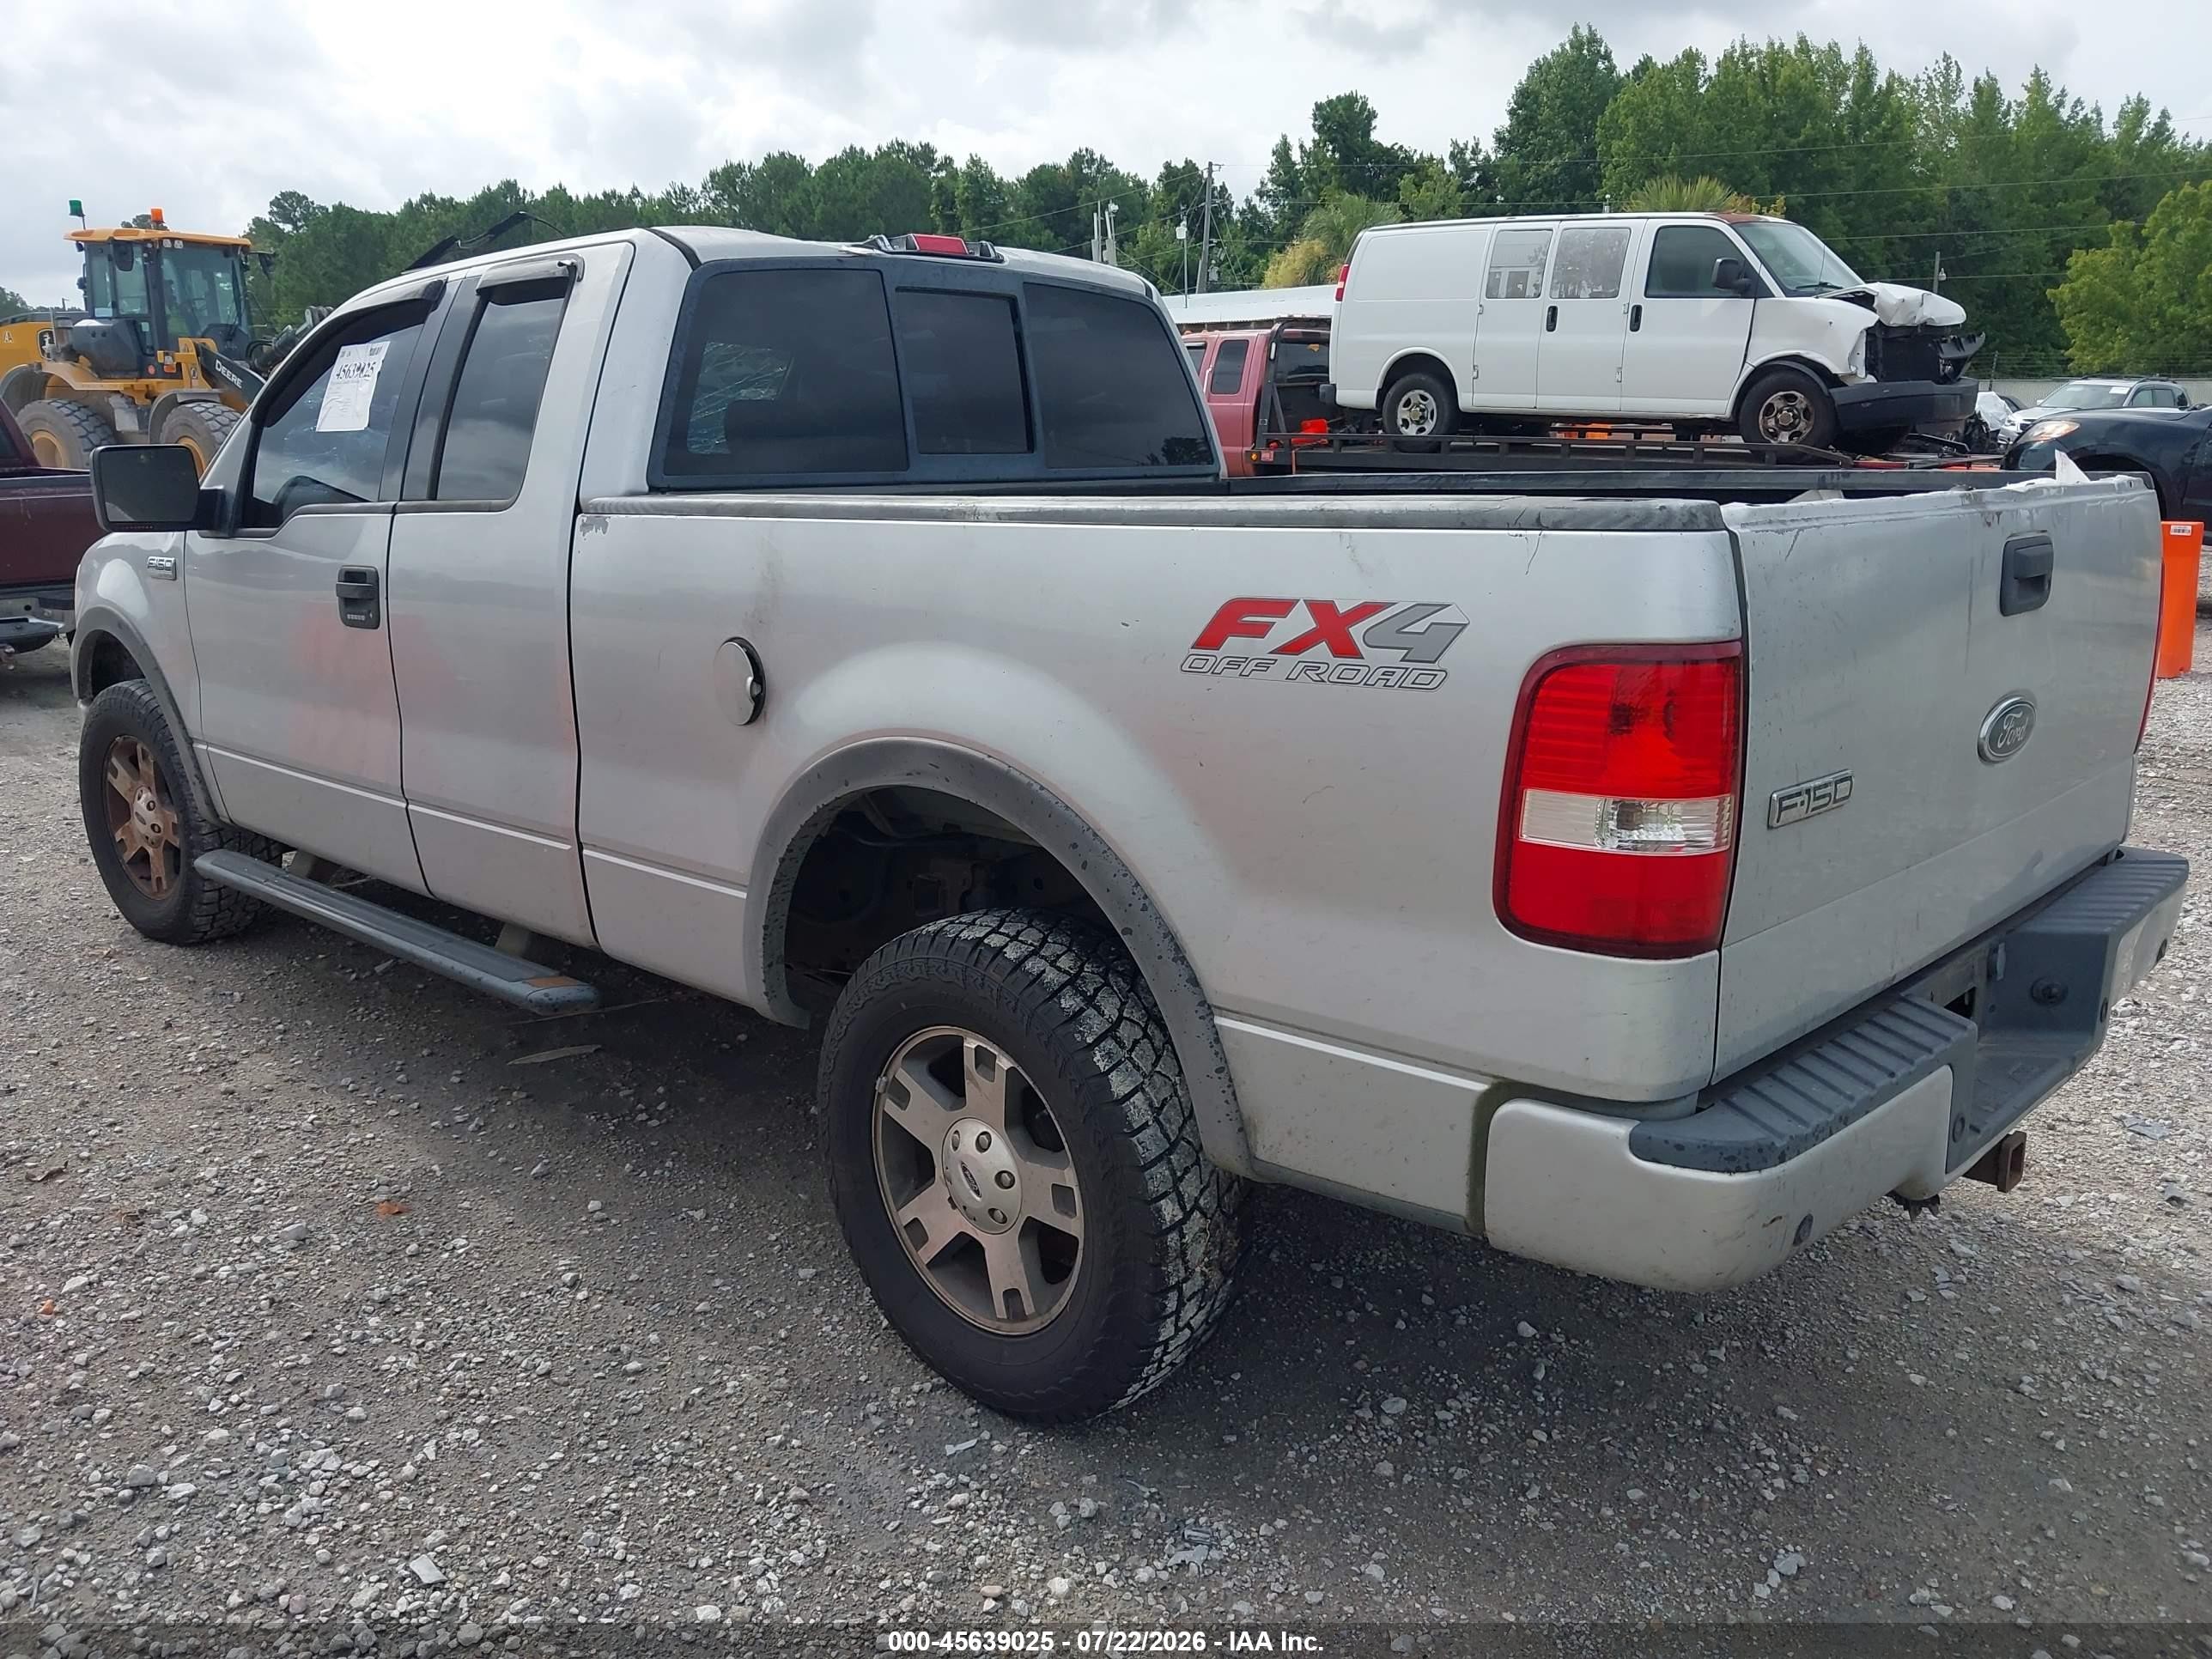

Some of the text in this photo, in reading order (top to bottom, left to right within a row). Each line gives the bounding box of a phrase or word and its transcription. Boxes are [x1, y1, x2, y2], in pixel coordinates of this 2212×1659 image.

[215, 359, 242, 389] DEERE
[1190, 597, 1470, 664] FX4
[1180, 653, 1449, 692] OFF ROAD
[1996, 709, 2030, 749] Ford
